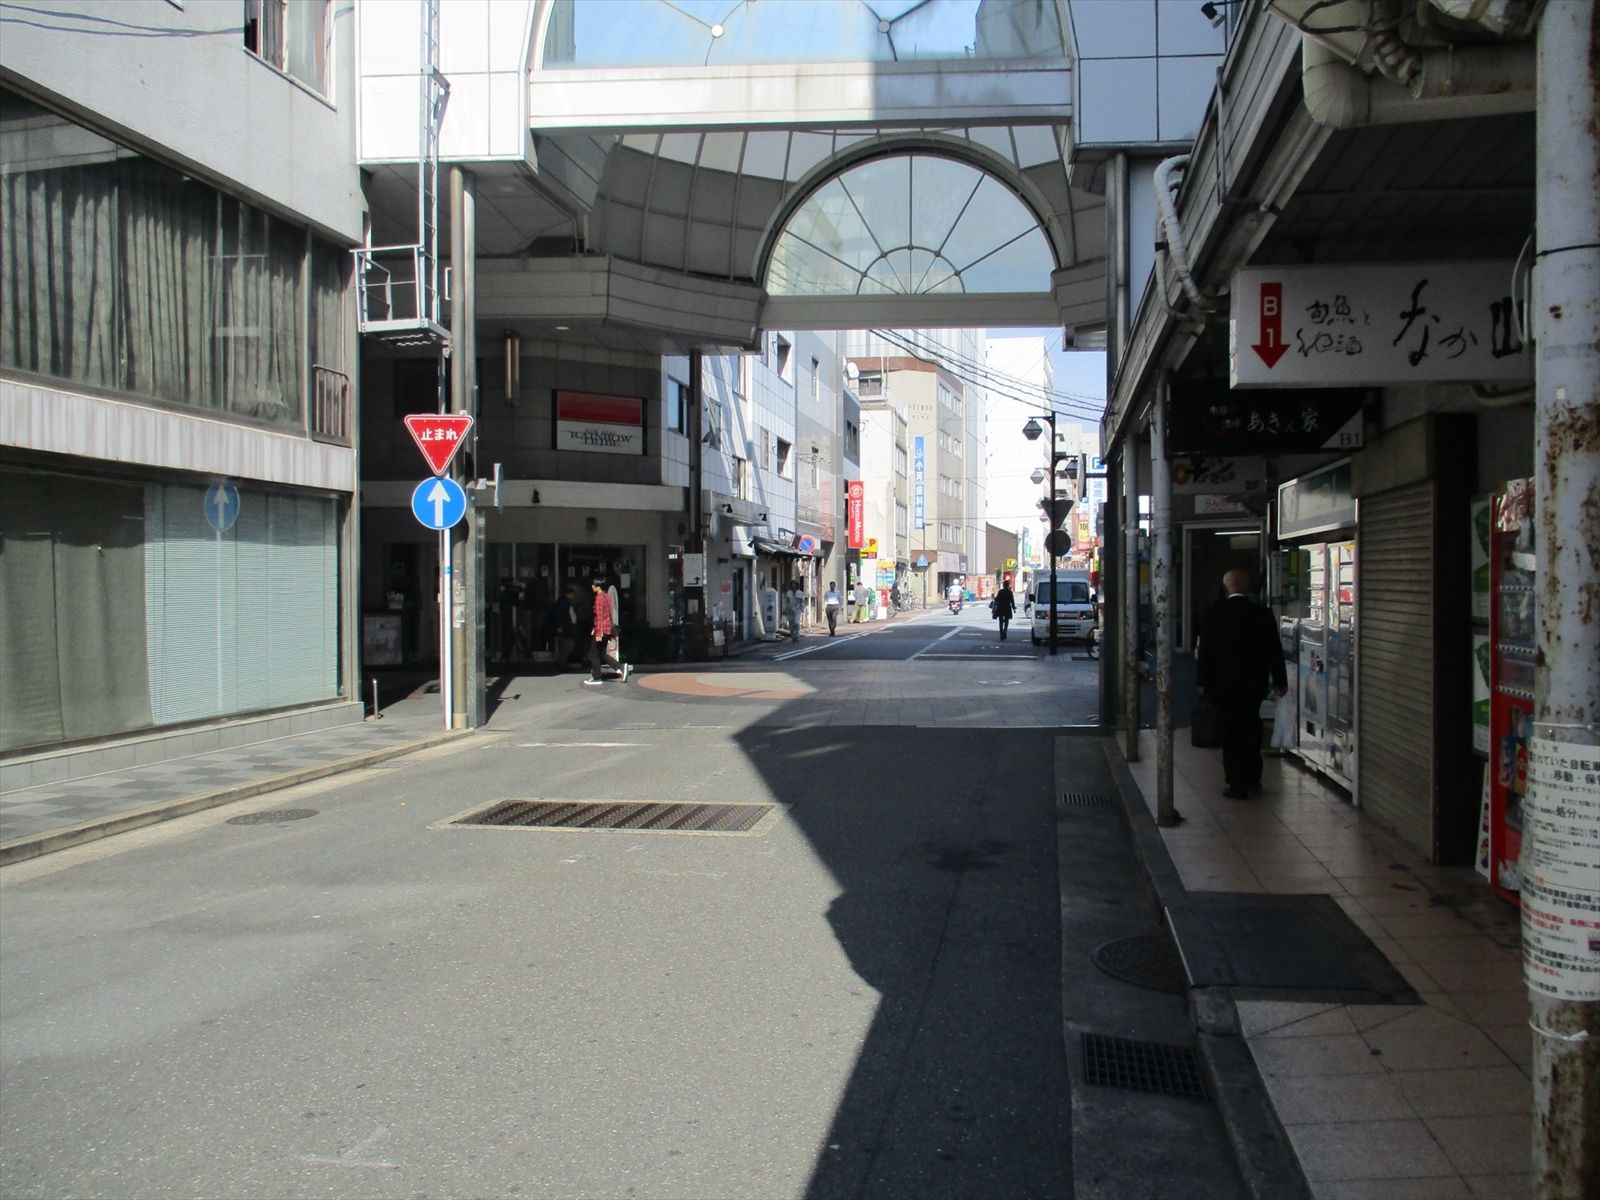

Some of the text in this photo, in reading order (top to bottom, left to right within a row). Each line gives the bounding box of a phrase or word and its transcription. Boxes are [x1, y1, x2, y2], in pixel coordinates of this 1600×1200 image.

[1263, 295, 1279, 348] B1
[420, 427, 459, 442] 止まれ
[1340, 432, 1362, 446] B1
[869, 538, 876, 547] P
[1554, 769, 1600, 785] 移動・保
[1556, 806, 1577, 819] 処分
